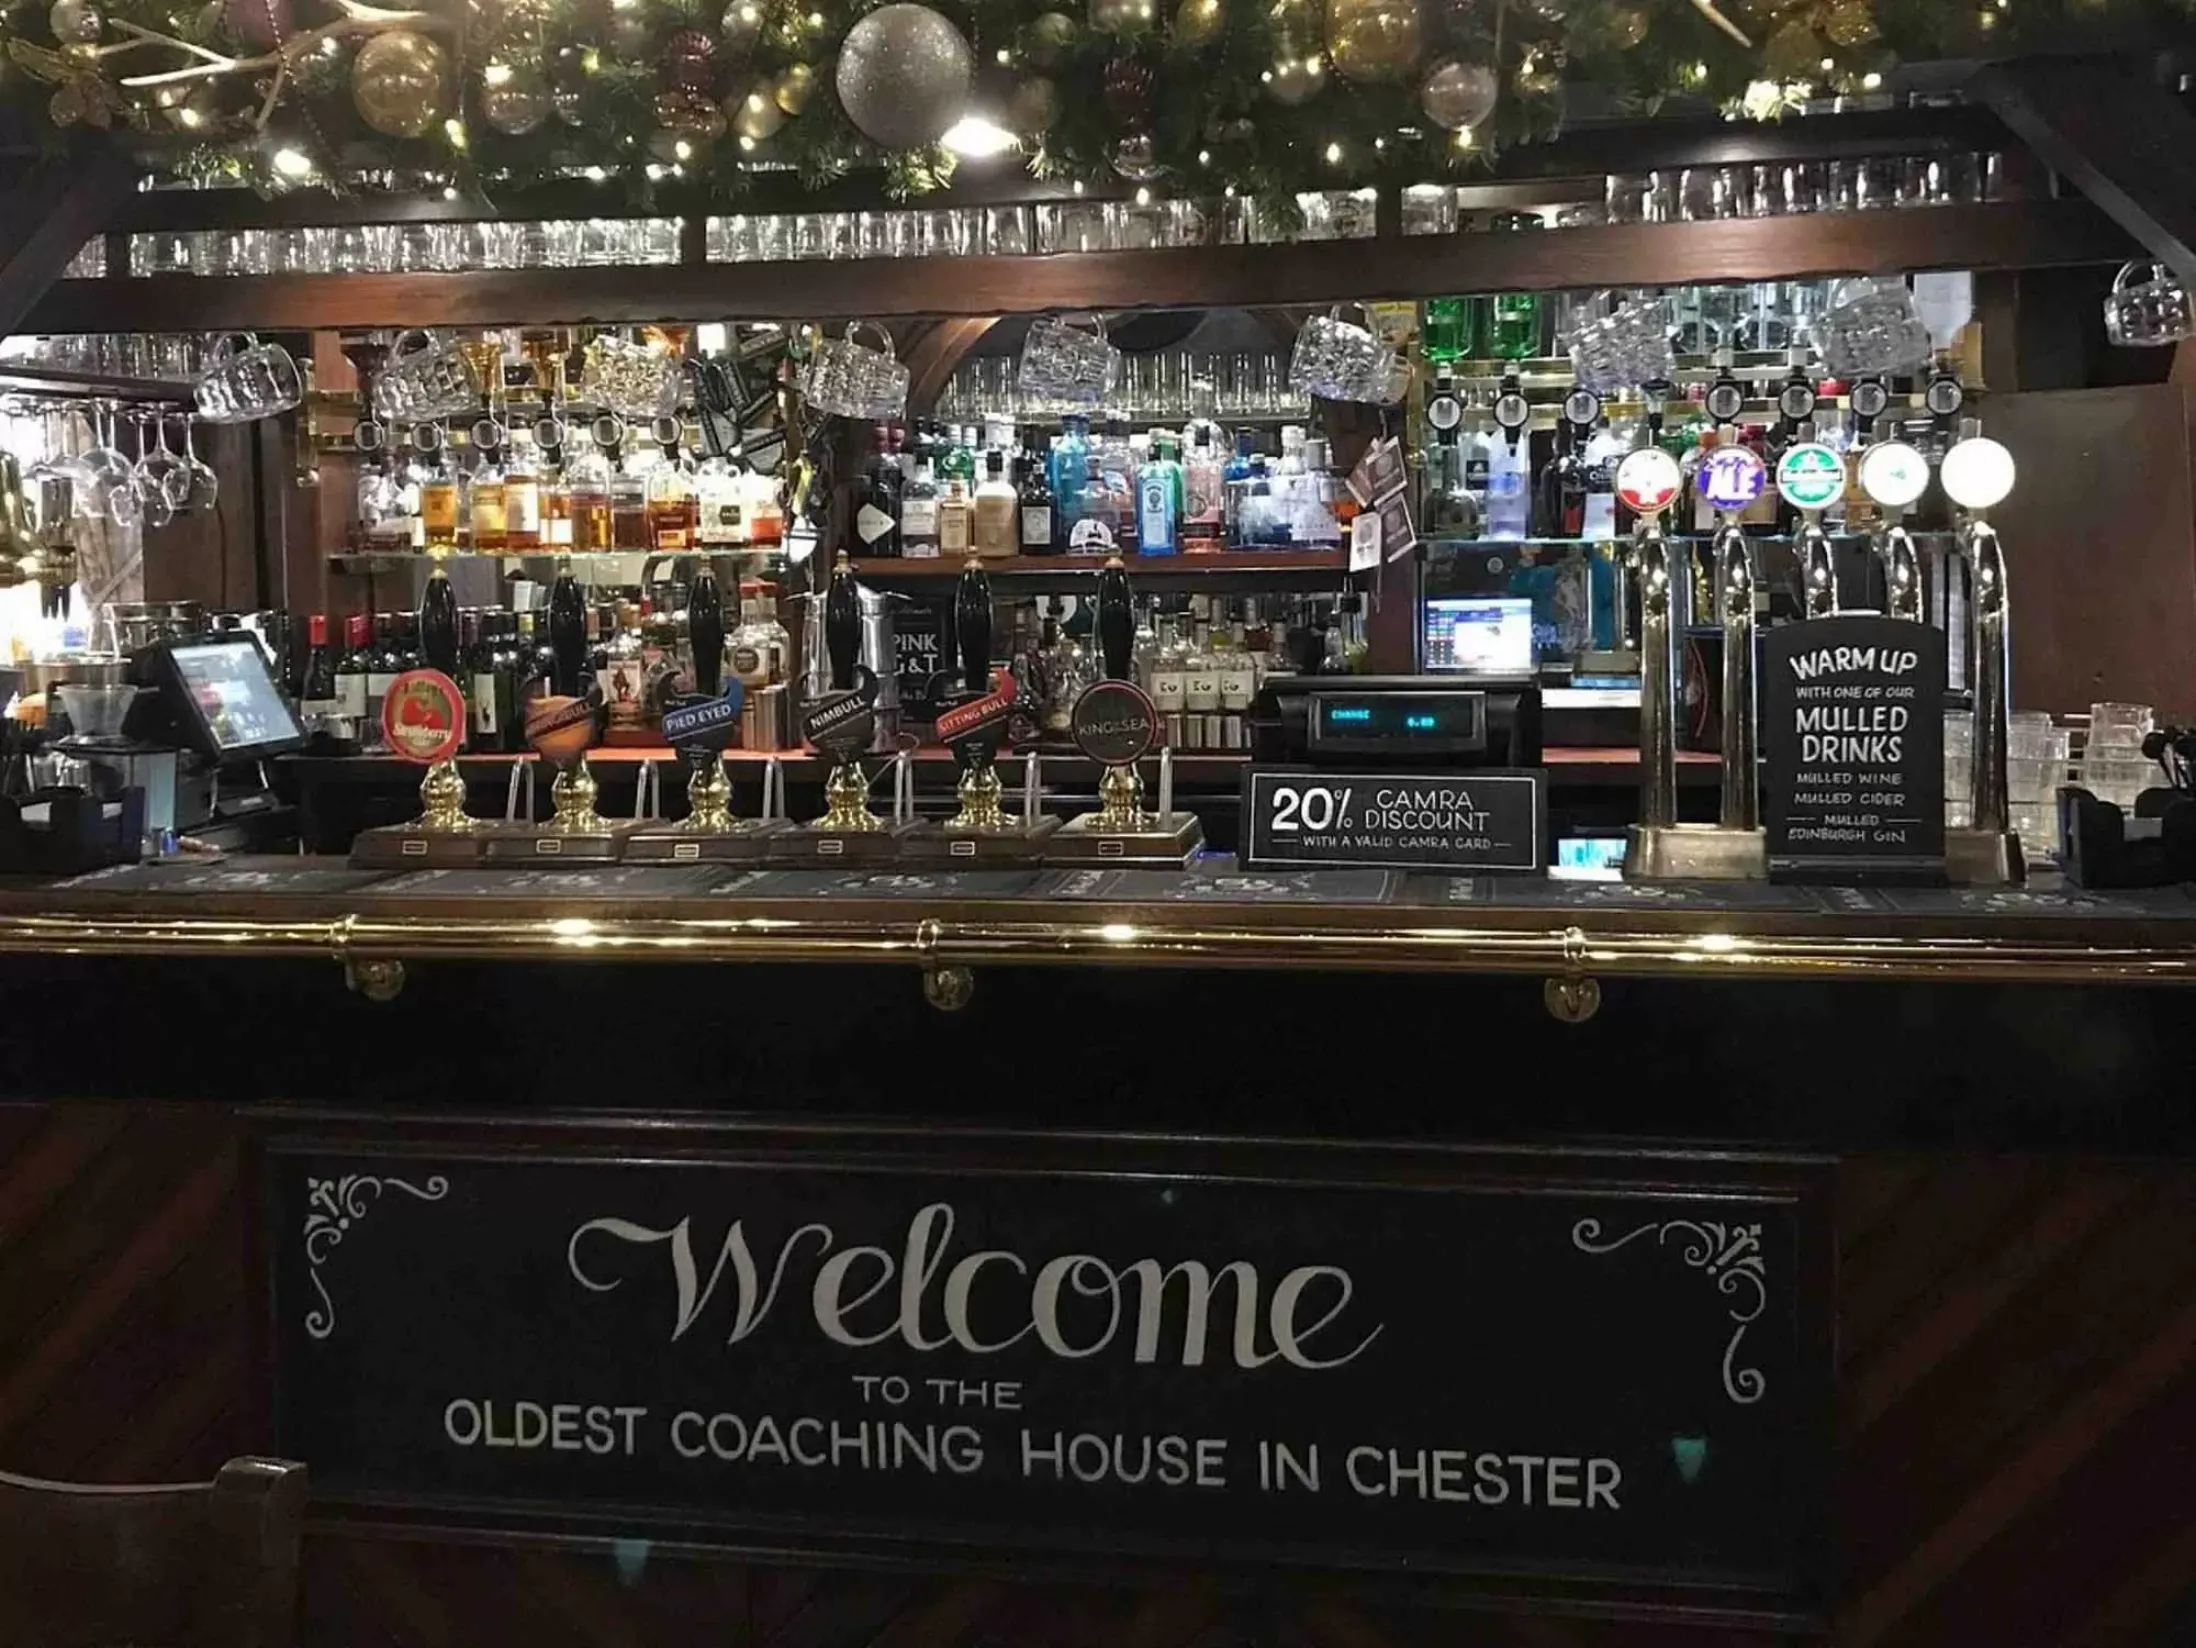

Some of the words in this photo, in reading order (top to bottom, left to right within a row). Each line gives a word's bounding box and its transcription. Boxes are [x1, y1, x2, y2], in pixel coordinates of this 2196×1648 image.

[1789, 646, 1876, 680] WARM
[1879, 649, 1918, 675] UP
[1795, 686, 1831, 699] WITH
[1833, 686, 1862, 699] ONE
[1864, 686, 1882, 699] OF
[1885, 687, 1915, 699] OUR
[666, 713, 696, 731] PIED
[697, 704, 731, 722] EYED
[810, 695, 867, 729] NIMBULL
[940, 710, 981, 731] SITTING
[981, 699, 1008, 716] BULL
[1795, 706, 1909, 734] MULLED
[1079, 721, 1114, 736] KING
[1120, 718, 1149, 732] SEA
[1802, 734, 1903, 763] DRINKS
[1796, 773, 1851, 784] MULLED
[1858, 773, 1902, 785] WINE
[1271, 787, 1353, 831] 20%
[1376, 789, 1475, 811] CAMRA
[1794, 793, 1851, 804] MULLED
[1859, 793, 1905, 806] CIDER
[1364, 810, 1490, 832] DISCOUNT
[1824, 815, 1879, 826] MULLED
[1303, 835, 1336, 847] WITH
[1340, 836, 1350, 846] A
[1354, 836, 1393, 848] VALID
[1399, 836, 1449, 849] CAMRA
[1455, 837, 1491, 849] CARD
[1788, 827, 1865, 842] EDINBURGH
[1872, 830, 1906, 843] GIN
[568, 1203, 1384, 1368] Welcome
[853, 1375, 911, 1404] TO
[926, 1378, 1023, 1409] THE
[444, 1398, 648, 1455] OLDEST
[671, 1411, 984, 1473] COACHING
[1020, 1429, 1227, 1487] HOUSE
[1260, 1440, 1320, 1492] IN
[1345, 1445, 1622, 1510] CHESTER
